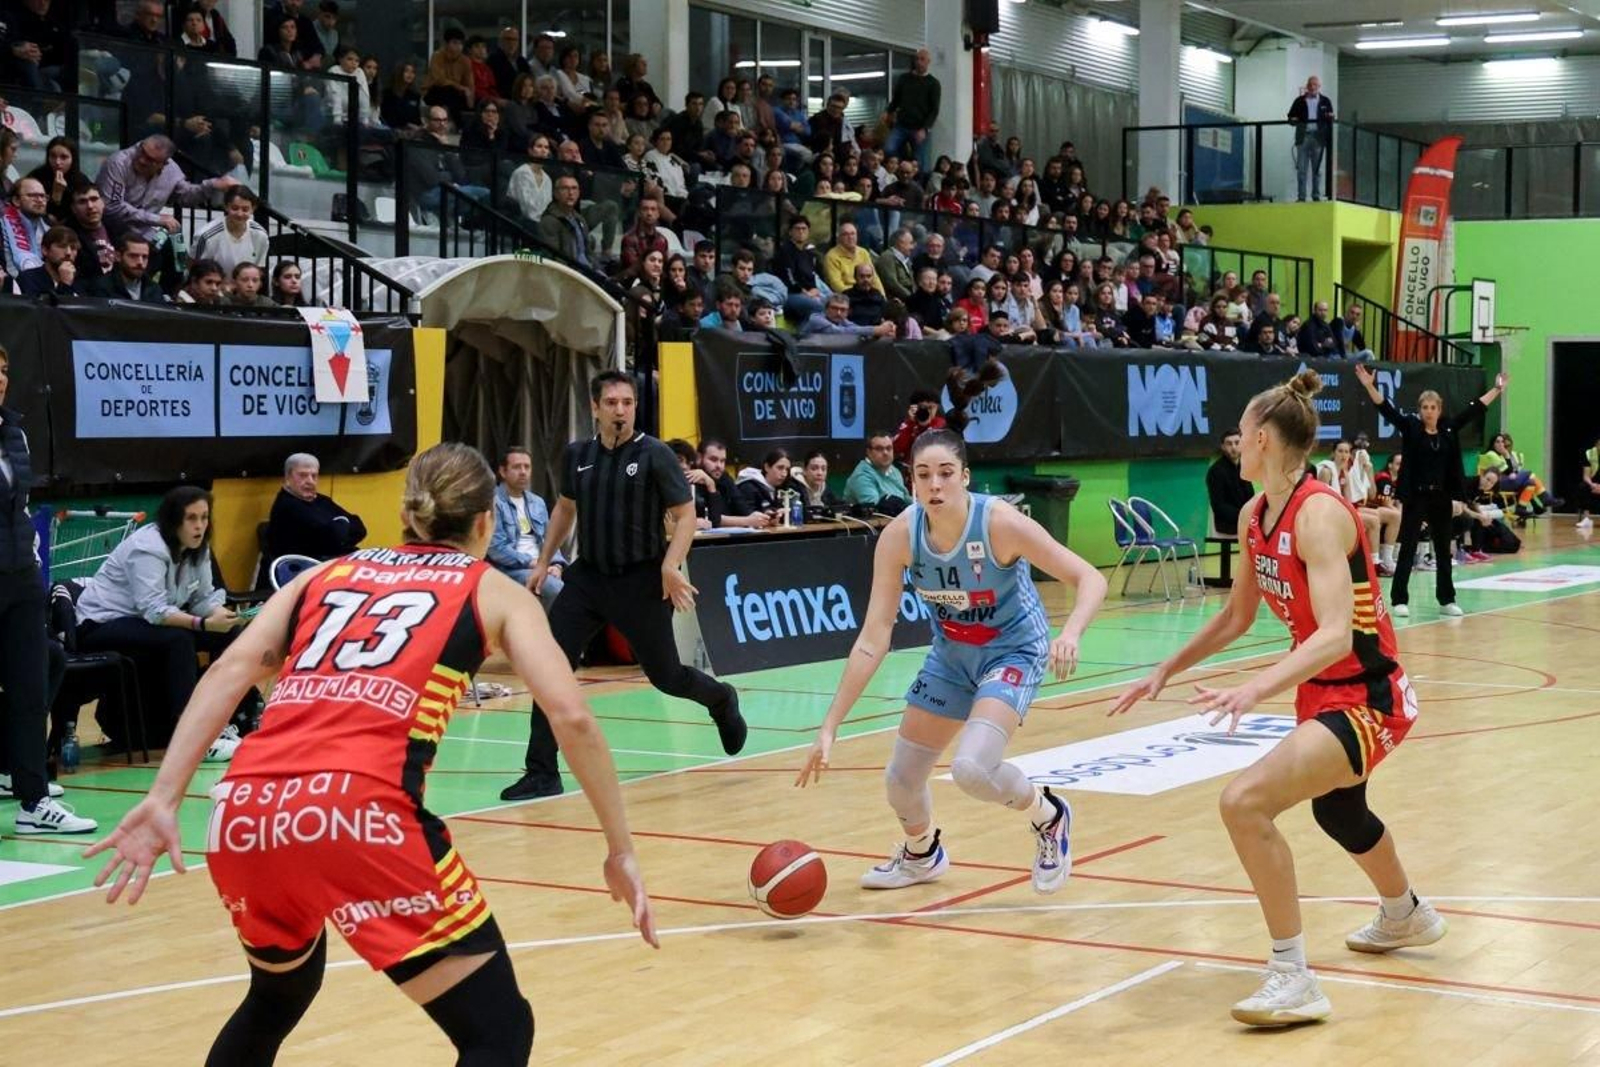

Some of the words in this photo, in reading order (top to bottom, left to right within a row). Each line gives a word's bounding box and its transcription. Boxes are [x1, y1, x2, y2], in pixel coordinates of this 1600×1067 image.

[1419, 256, 1430, 292] VIGO
[1415, 298, 1426, 316] DE
[84, 361, 204, 382] CONCELLERÍA
[230, 365, 315, 386] CONCELL
[743, 371, 822, 393] CONCLLO
[141, 385, 153, 394] DE
[101, 400, 191, 417] DEPORTES
[243, 395, 268, 416] DE
[275, 395, 320, 416] VIGO
[754, 399, 776, 420] DE
[781, 398, 816, 419] VIGO
[350, 566, 465, 584] parlem
[1255, 554, 1279, 578] SPAR
[935, 567, 961, 589] 14
[724, 573, 858, 644] femxa
[294, 587, 440, 673] 13
[225, 802, 405, 853] GIRONÈS
[332, 890, 445, 937] ginvest
